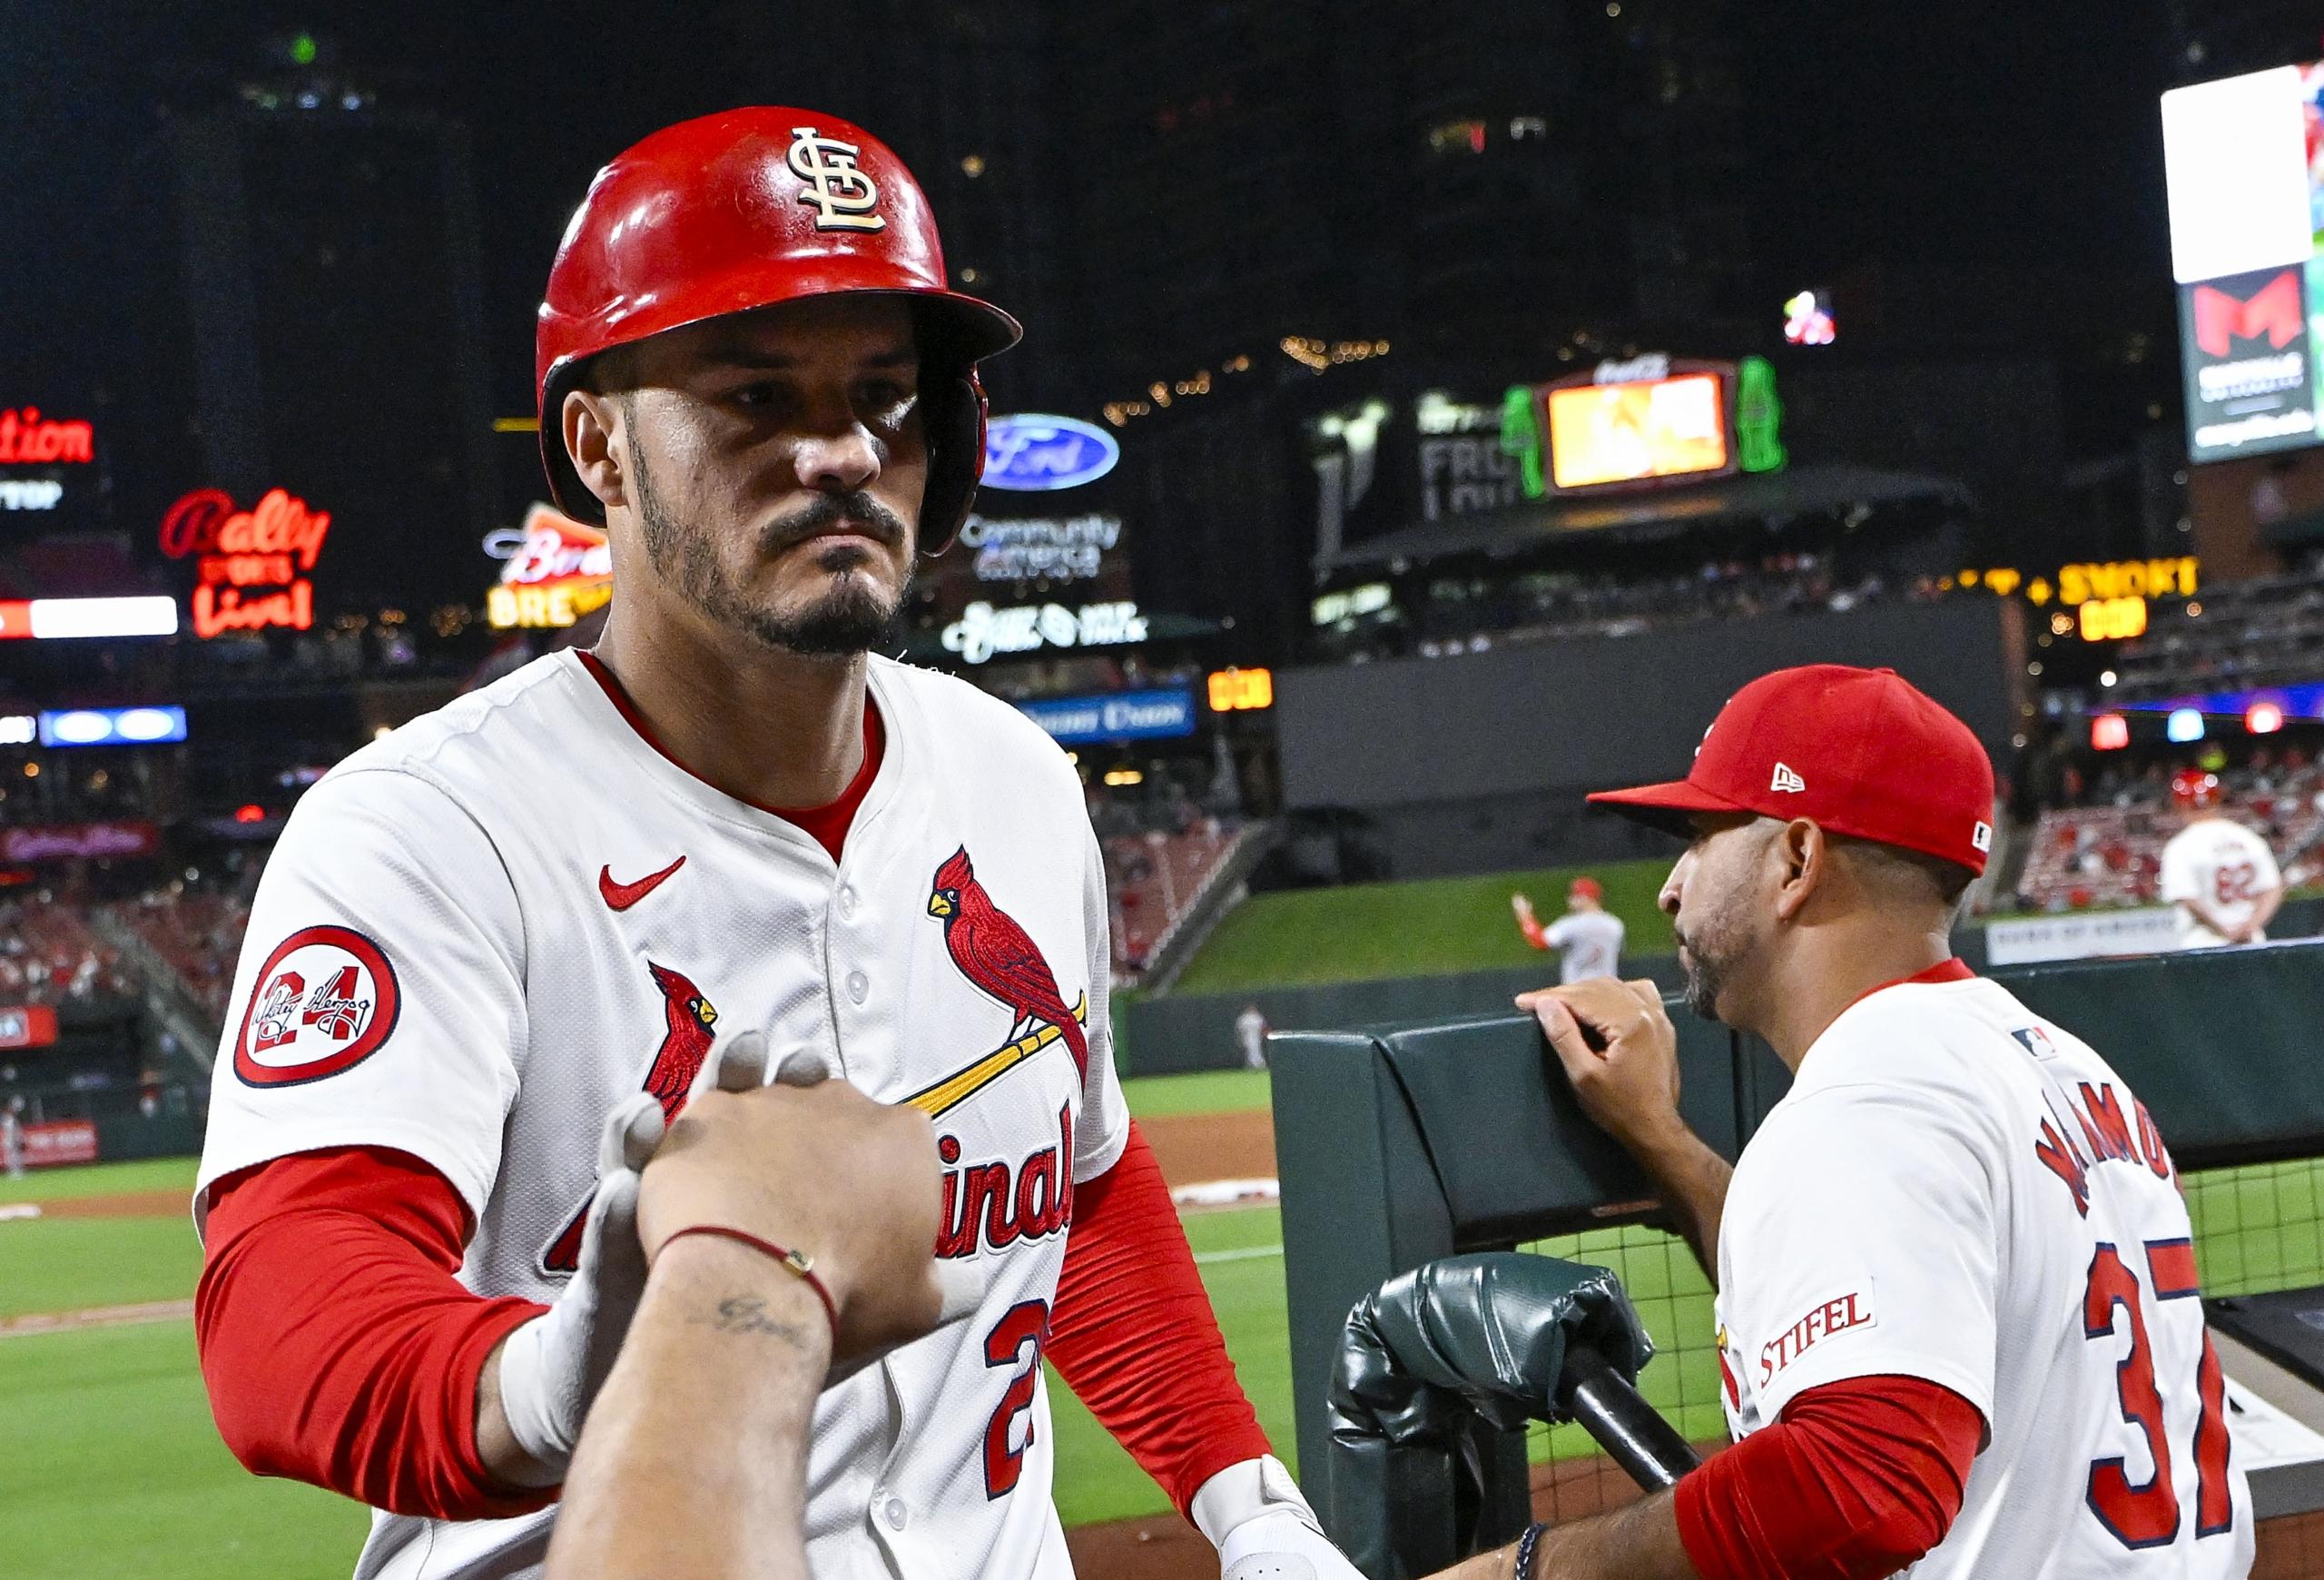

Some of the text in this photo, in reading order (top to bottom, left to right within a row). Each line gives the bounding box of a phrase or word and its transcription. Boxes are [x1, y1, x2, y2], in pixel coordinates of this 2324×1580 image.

[253, 966, 360, 1054] 24
[1761, 1292, 1871, 1390] STIFEL
[2084, 1238, 2232, 1551] 37
